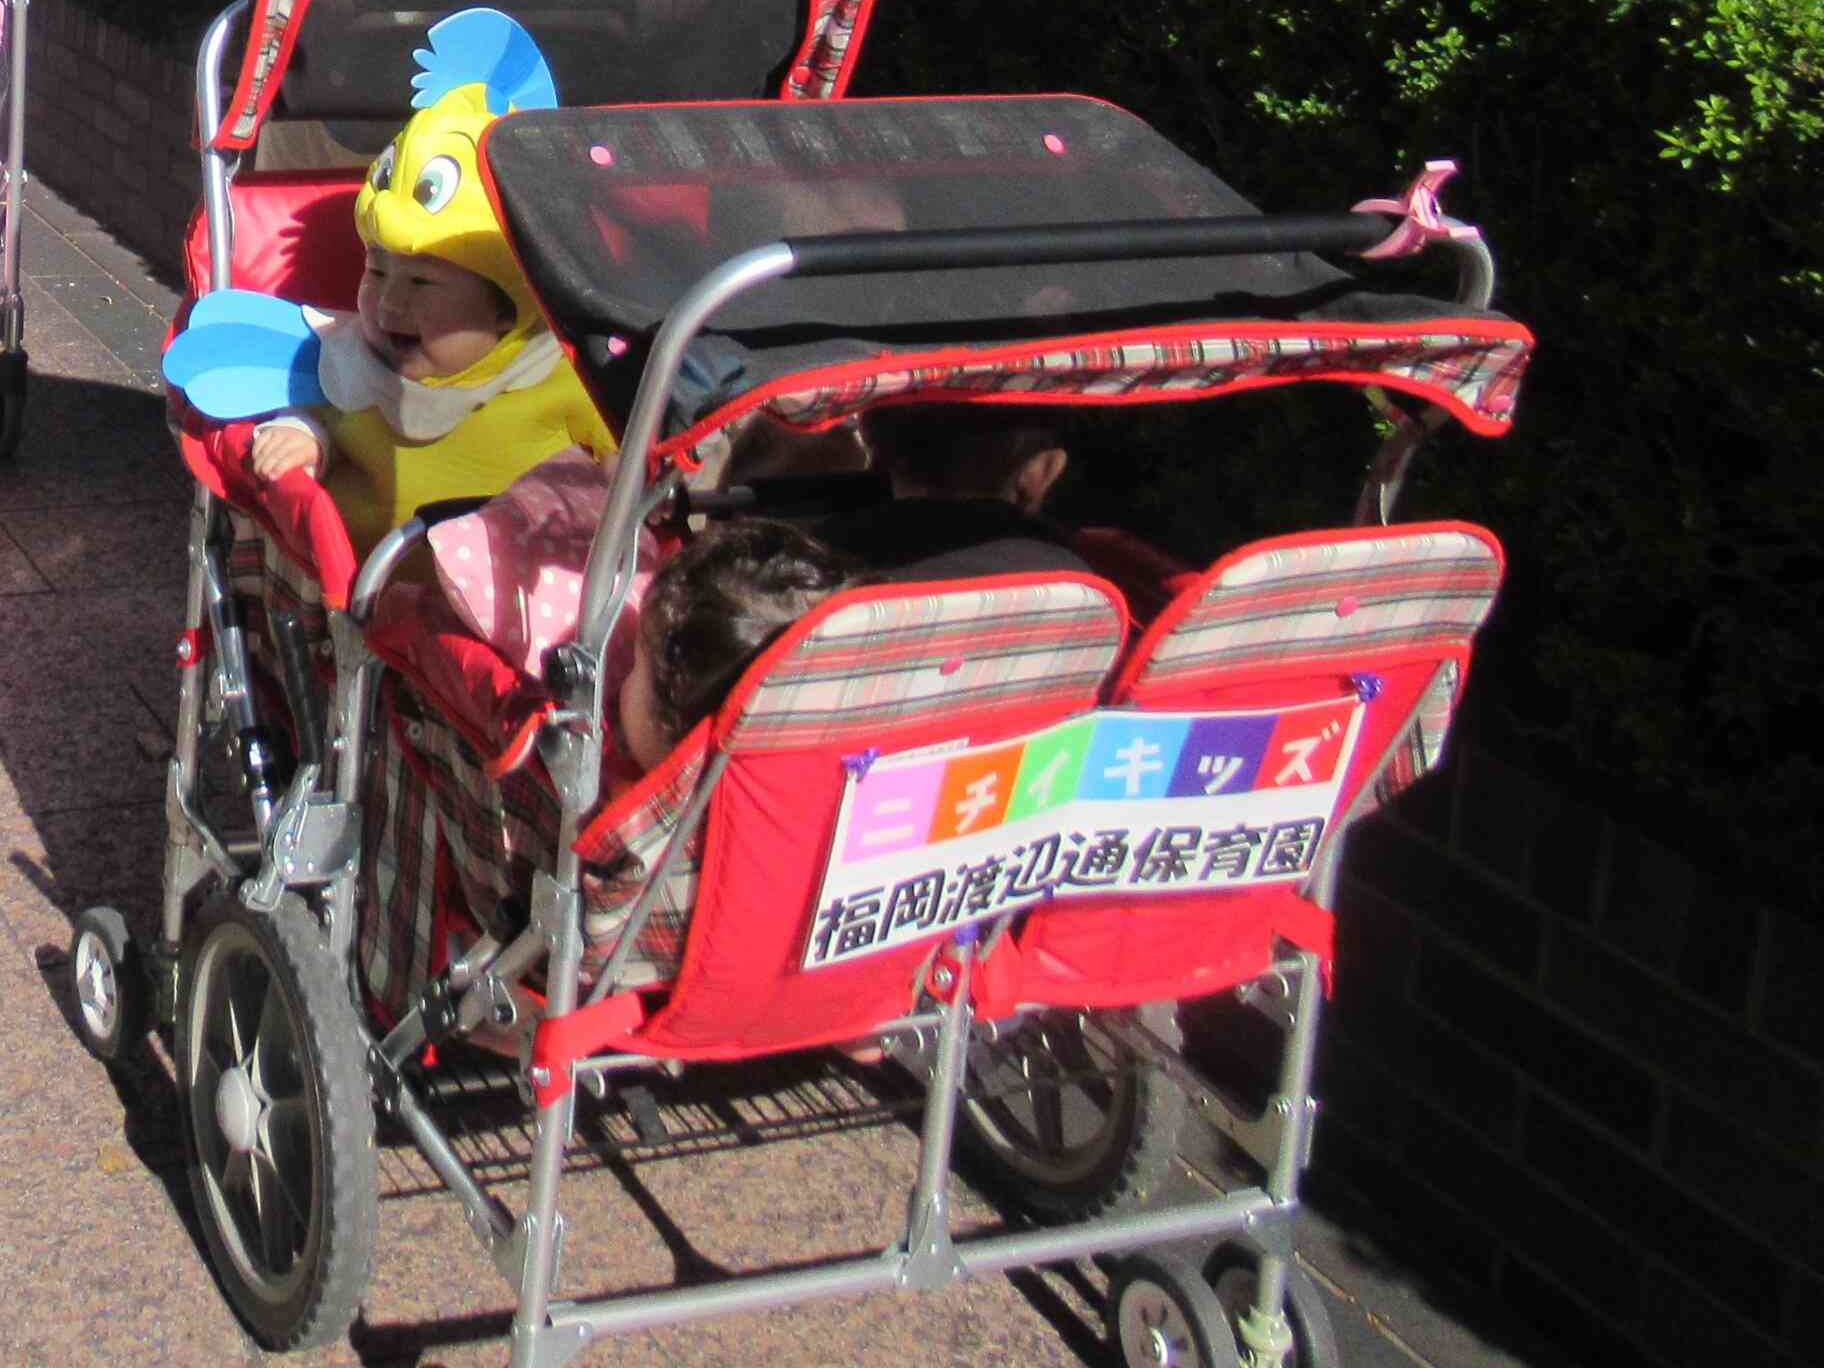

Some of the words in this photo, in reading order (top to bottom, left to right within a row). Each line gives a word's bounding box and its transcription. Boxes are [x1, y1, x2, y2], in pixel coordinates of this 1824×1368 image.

[859, 720, 1341, 848] ニチイキッズ
[813, 816, 1326, 962] 福岡渡辺通保育園
